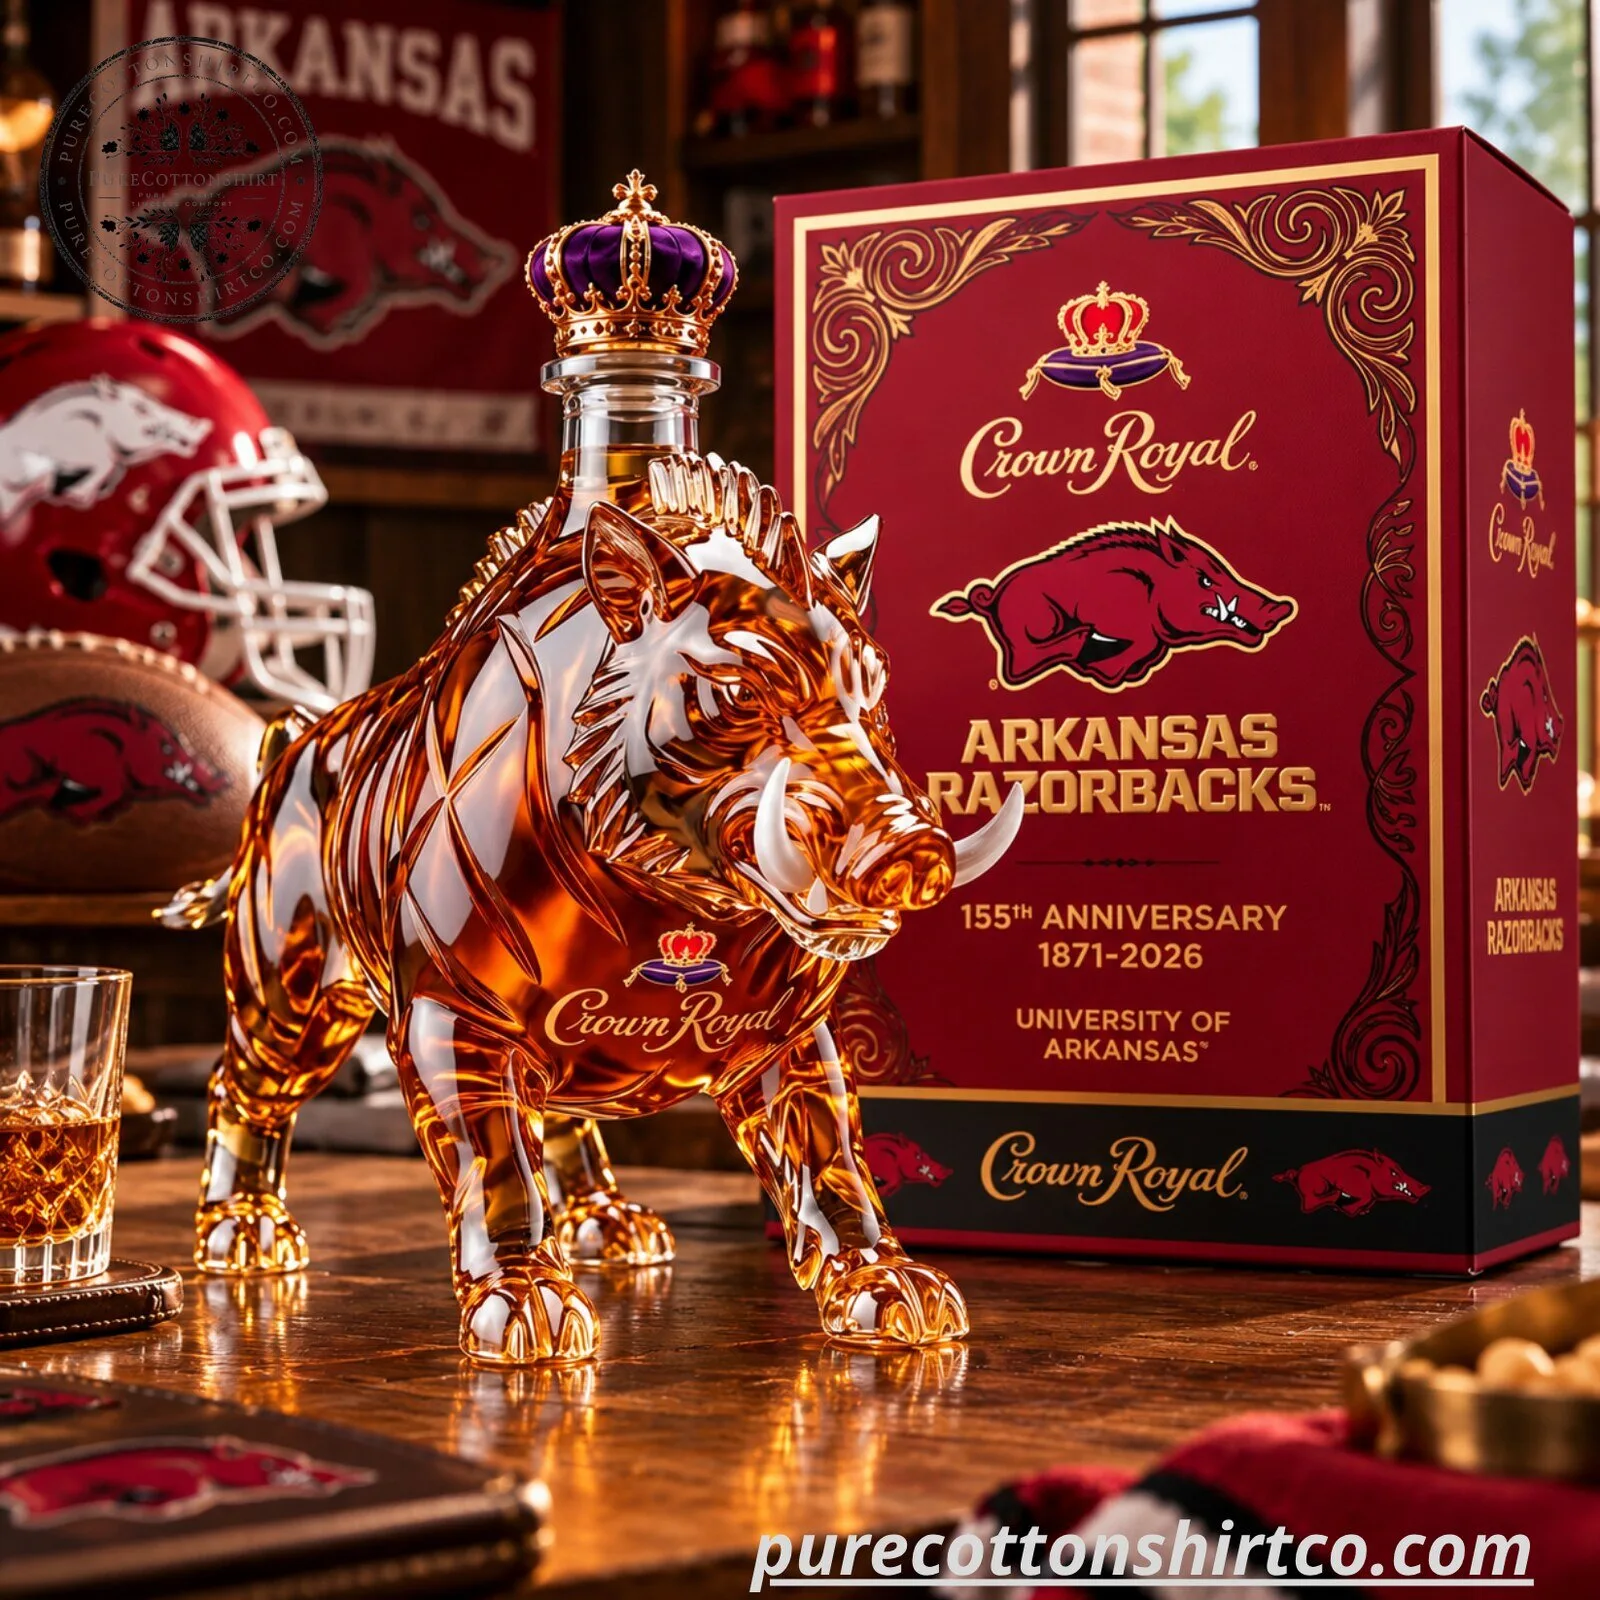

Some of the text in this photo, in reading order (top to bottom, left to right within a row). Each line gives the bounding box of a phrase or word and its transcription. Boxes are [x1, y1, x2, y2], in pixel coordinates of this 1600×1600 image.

[134, 0, 538, 153] ARKANSAS
[959, 410, 1257, 499] Crown Royal
[961, 713, 1279, 763] ARKANSAS
[926, 767, 1318, 815] RAZORBACKS
[1494, 877, 1557, 912] ARKANSAS
[1042, 904, 1288, 931] ANNIVERSARY
[1487, 918, 1564, 955] RAZORBACKS
[1038, 942, 1203, 969] 1871-2026
[544, 987, 795, 1053] Crown Royal
[1016, 1008, 1231, 1033] UNIVERSITY OF
[1043, 1038, 1200, 1063] ARKANSAS
[981, 1131, 1249, 1212] Crown Royal
